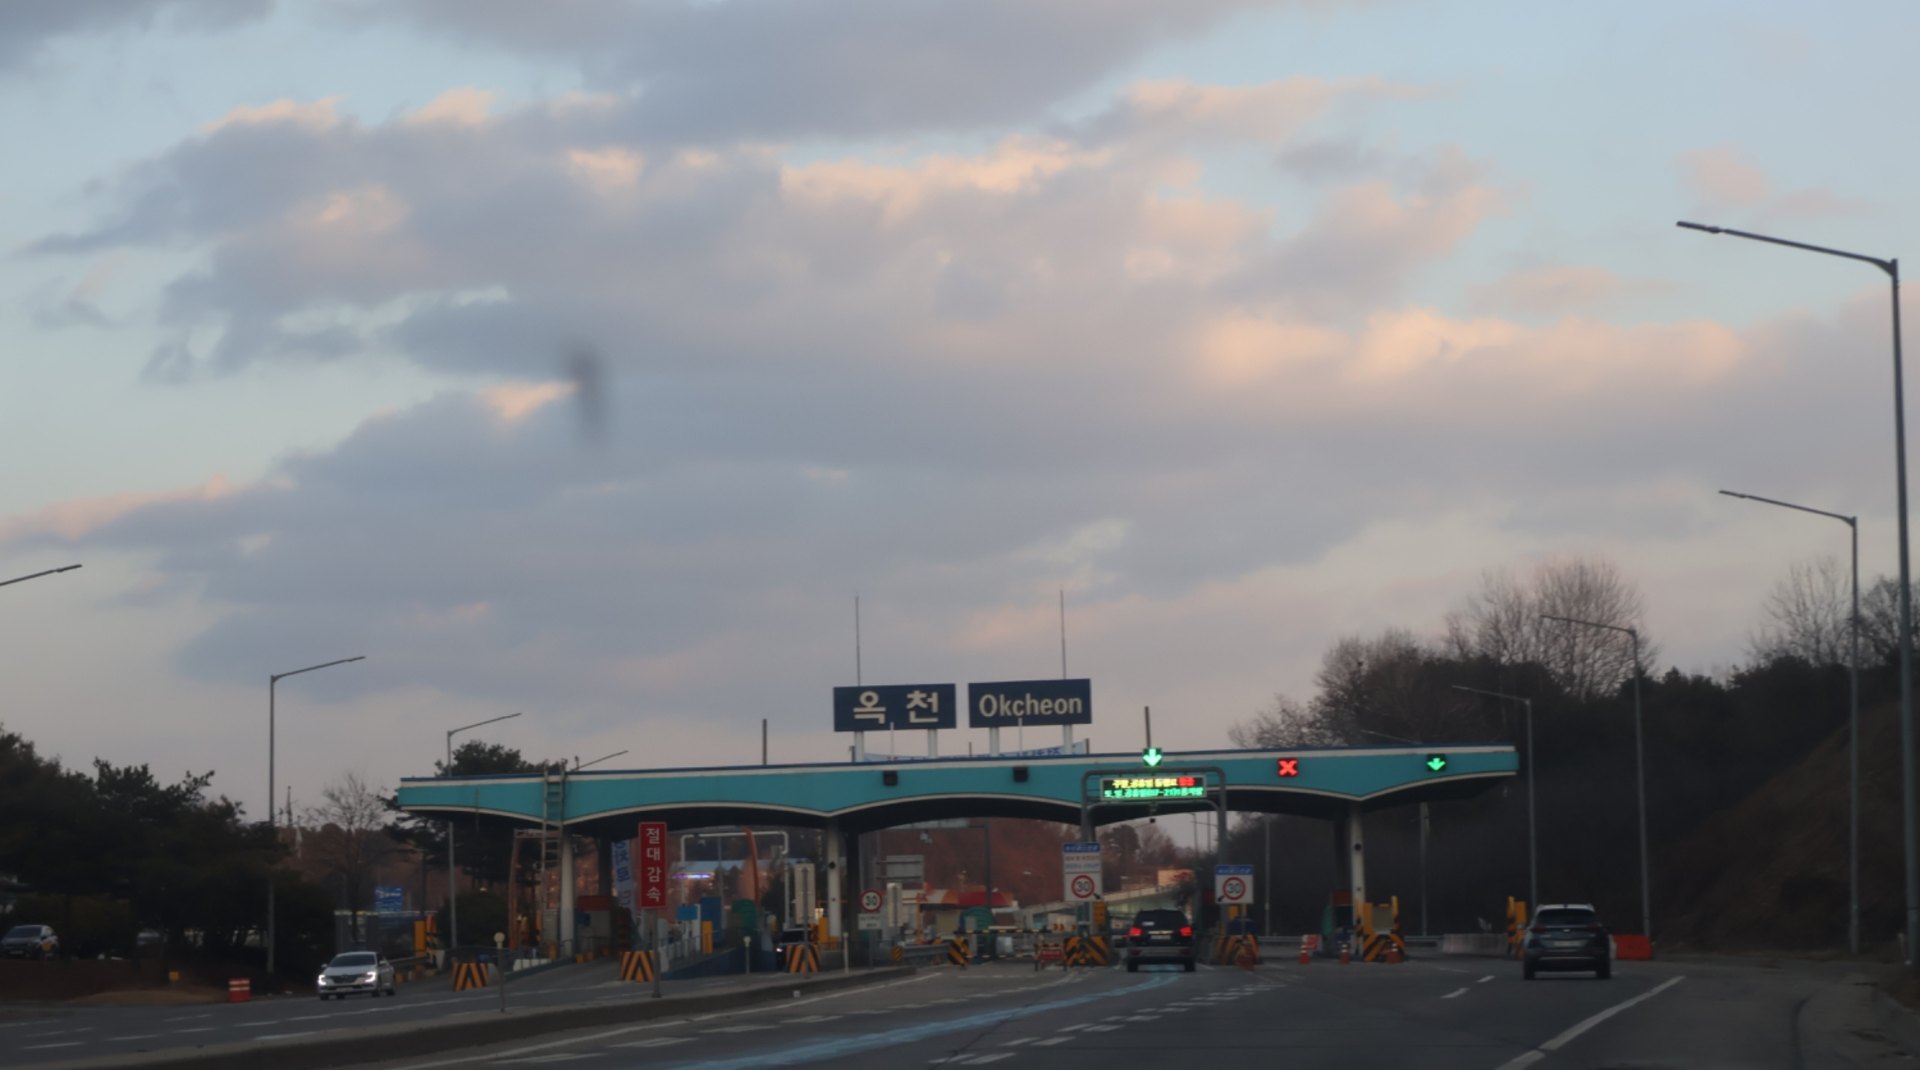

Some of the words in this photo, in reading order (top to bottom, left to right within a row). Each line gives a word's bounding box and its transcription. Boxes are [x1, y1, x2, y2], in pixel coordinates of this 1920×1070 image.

[979, 693, 1083, 717] Okcheon
[1076, 880, 1091, 892] 30
[1227, 882, 1242, 894] 30
[865, 895, 878, 906] 30
